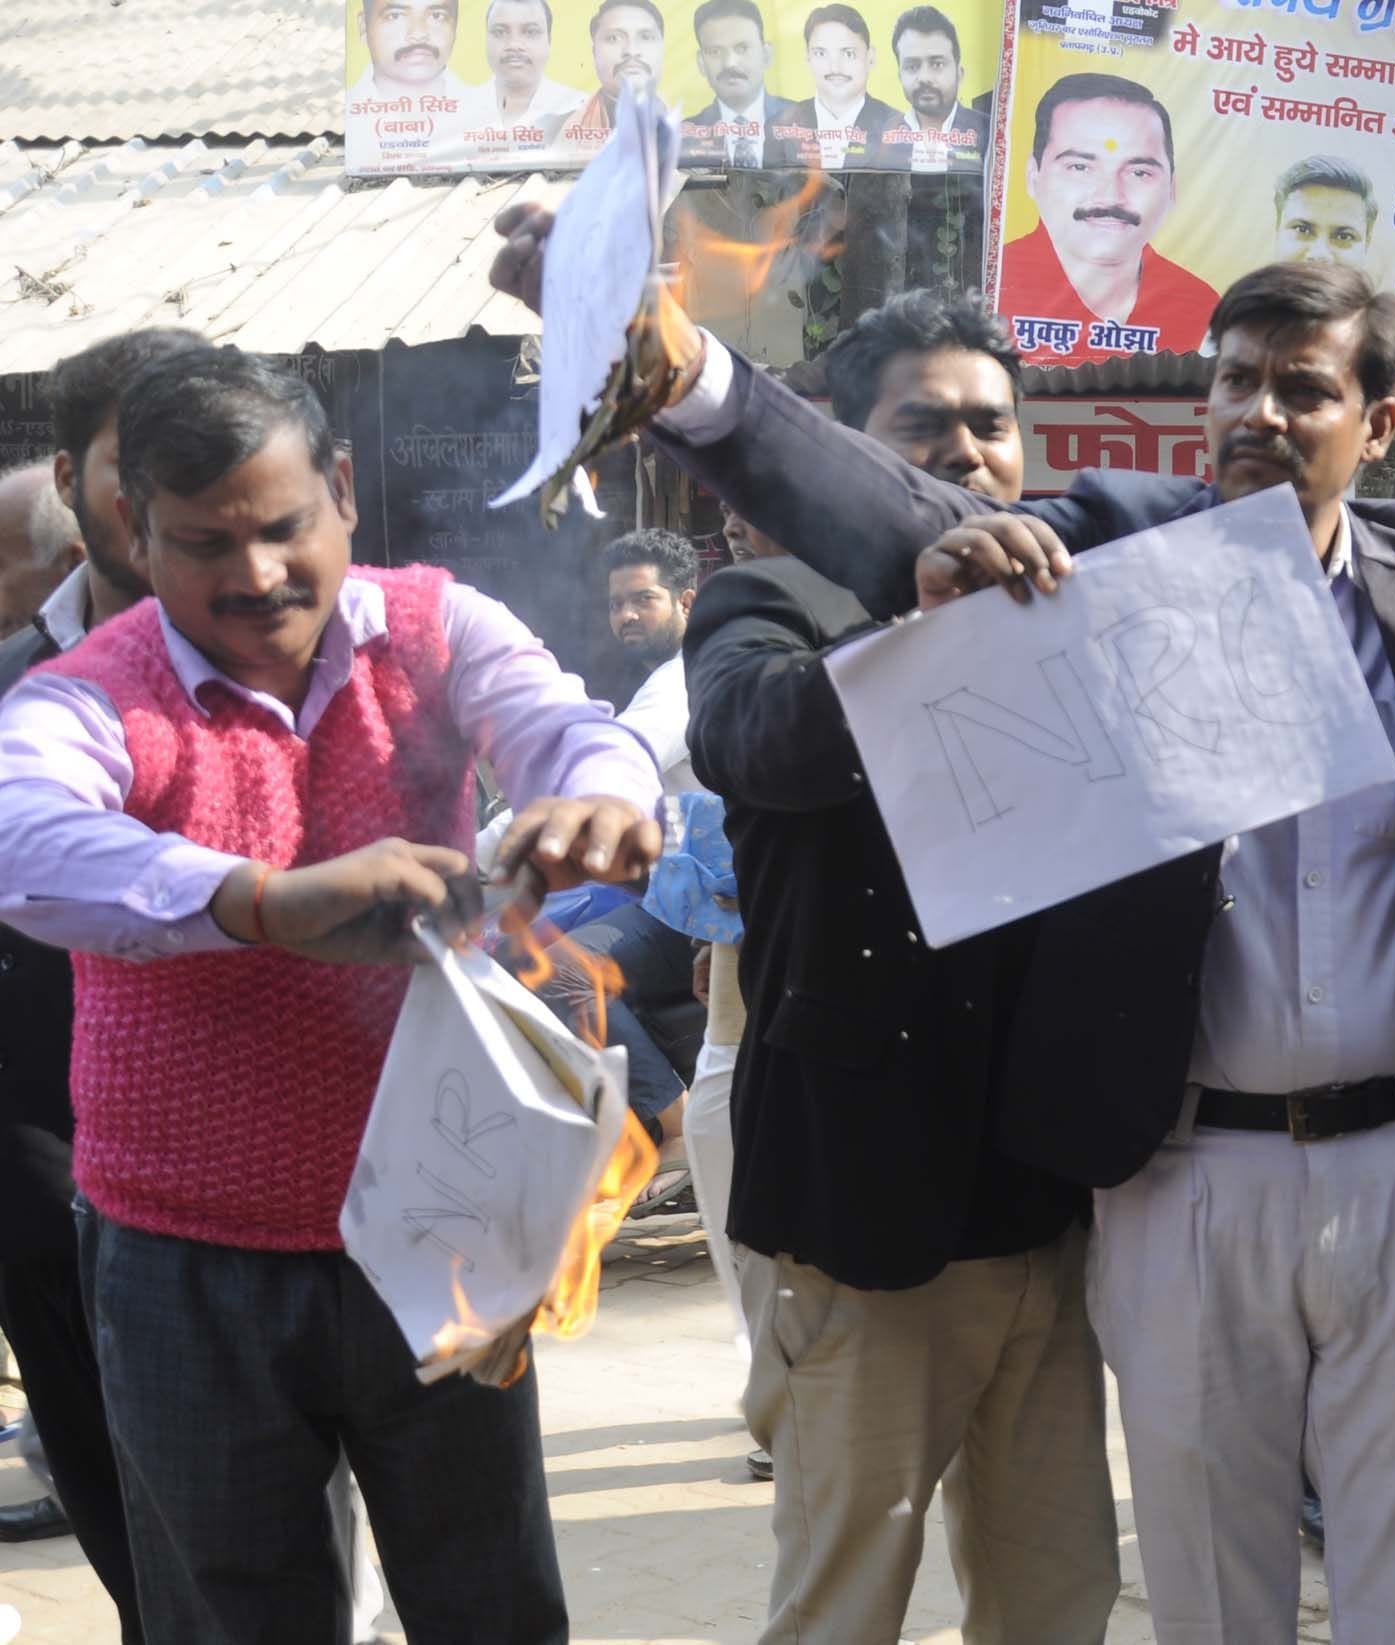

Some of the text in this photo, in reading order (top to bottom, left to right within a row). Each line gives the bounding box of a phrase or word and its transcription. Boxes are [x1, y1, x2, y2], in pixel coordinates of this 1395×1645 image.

[1207, 33, 1268, 65] आये
[1273, 40, 1320, 83] हुये
[351, 95, 460, 115] अंजनी सिंह
[1212, 85, 1259, 117] एवं
[1261, 96, 1387, 135] सम्मानित
[374, 116, 435, 138] (बाबा)
[512, 125, 545, 143] सिंह
[814, 128, 842, 142] प्रताप
[844, 126, 868, 144] सिंह
[1089, 319, 1159, 352] ओझा
[921, 576, 1323, 834] NRC
